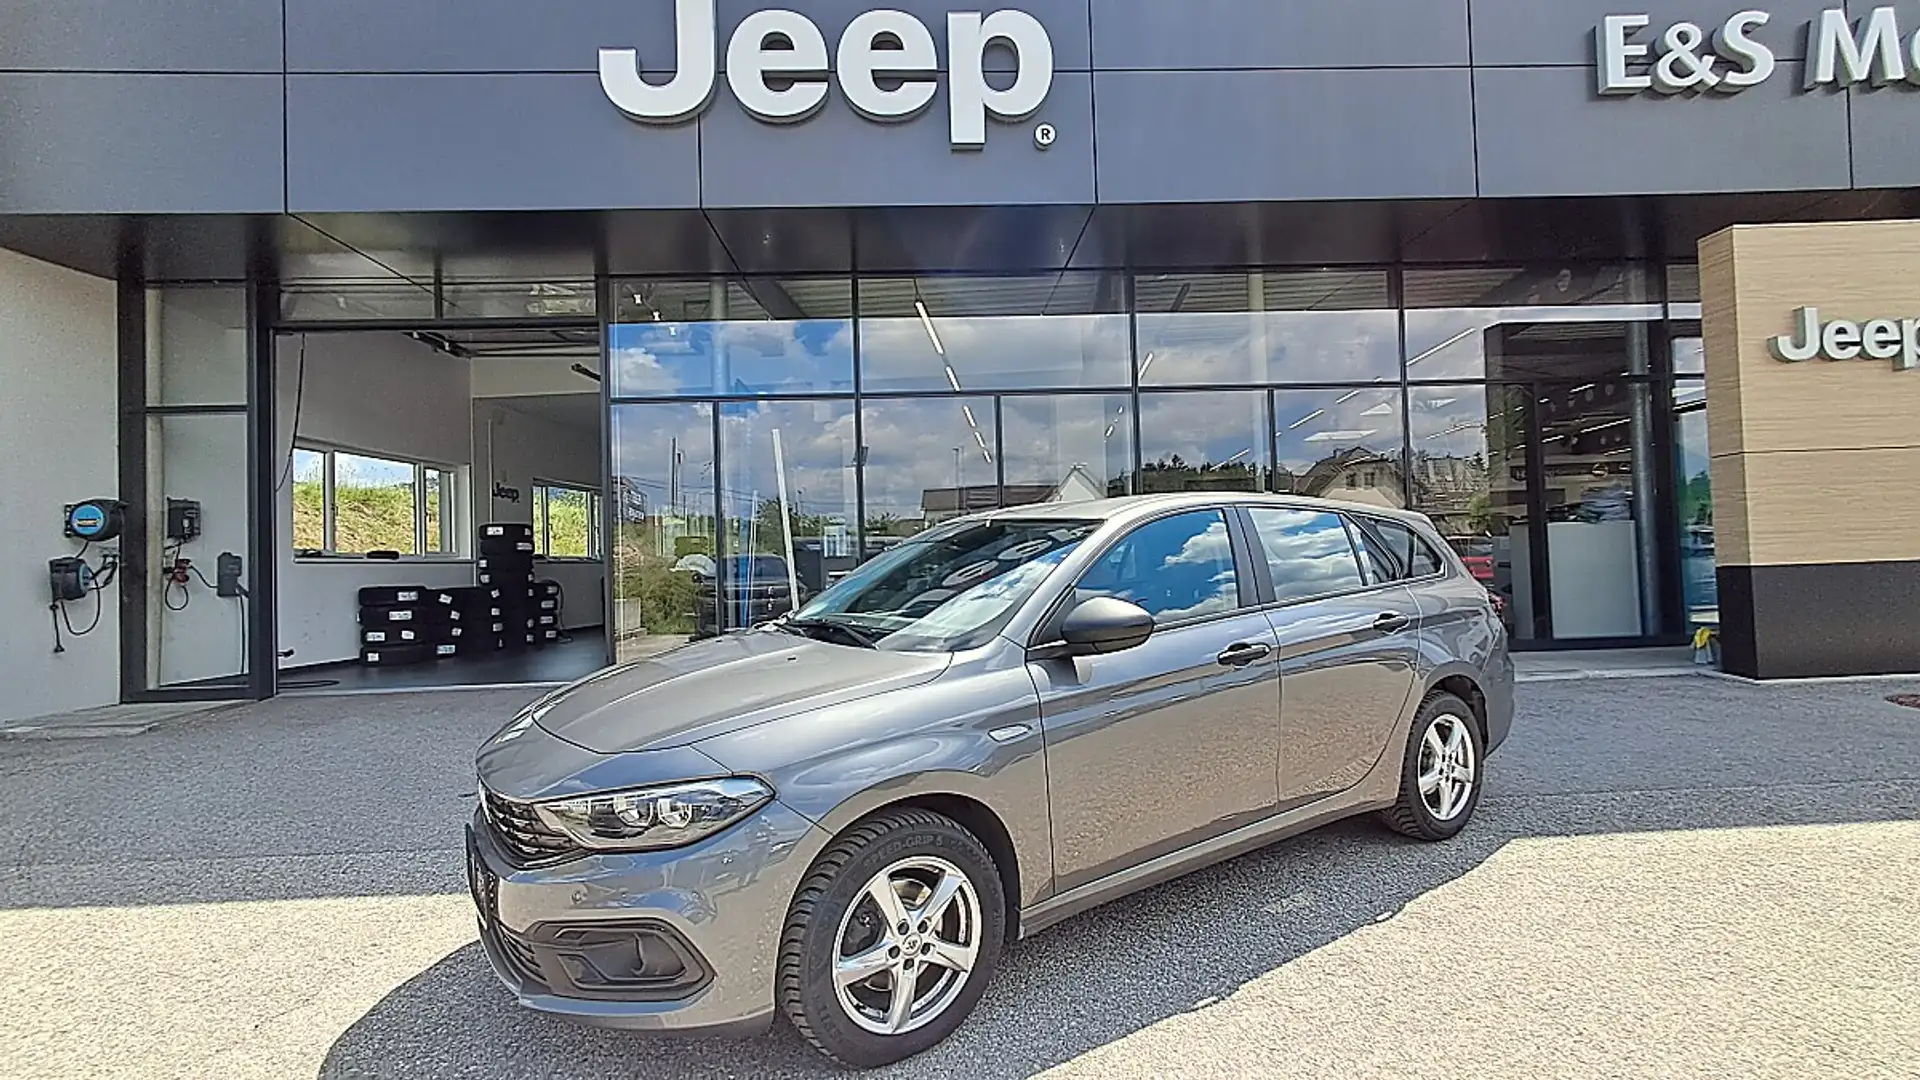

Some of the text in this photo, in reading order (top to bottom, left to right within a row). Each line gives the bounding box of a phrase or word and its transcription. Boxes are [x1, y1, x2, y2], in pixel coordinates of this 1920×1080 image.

[598, 0, 1054, 150] Jeep
[1597, 6, 1920, 93] E&S M
